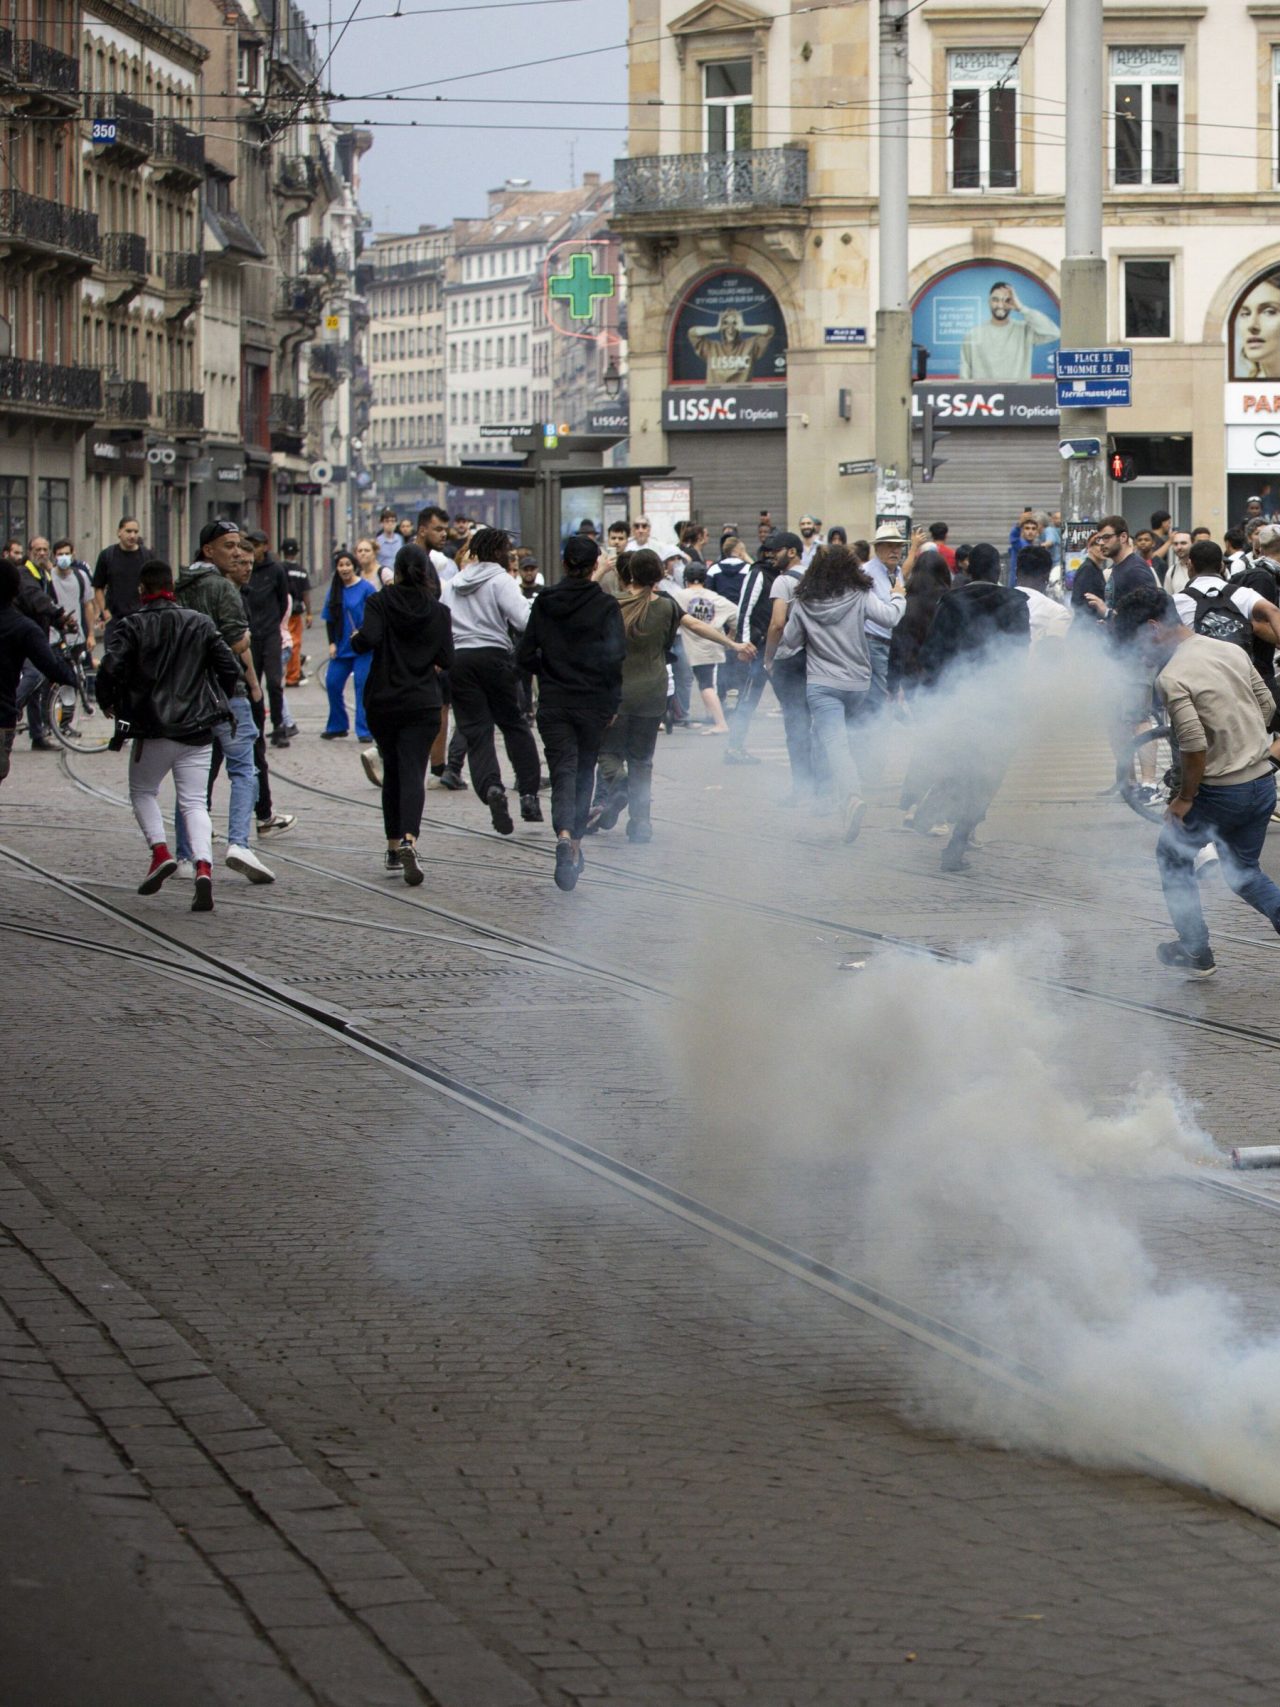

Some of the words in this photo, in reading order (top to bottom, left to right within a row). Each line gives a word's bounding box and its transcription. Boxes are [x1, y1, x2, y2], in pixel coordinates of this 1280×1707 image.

[92, 124, 116, 138] 350
[711, 356, 751, 370] LISSAC
[1074, 354, 1100, 363] PLACE
[1103, 353, 1114, 363] DE
[1059, 365, 1098, 375] L'HOMME
[1101, 364, 1112, 374] DE
[1115, 364, 1130, 374] FER
[668, 397, 737, 421] LISSAC
[740, 409, 779, 422] l'Opticien
[1009, 404, 1061, 419] l'Opticien
[592, 416, 629, 426] LISSAC
[481, 428, 508, 436] Homme
[509, 427, 519, 436] de
[520, 427, 532, 436] Fer
[546, 423, 555, 434] B
[558, 423, 569, 436] C
